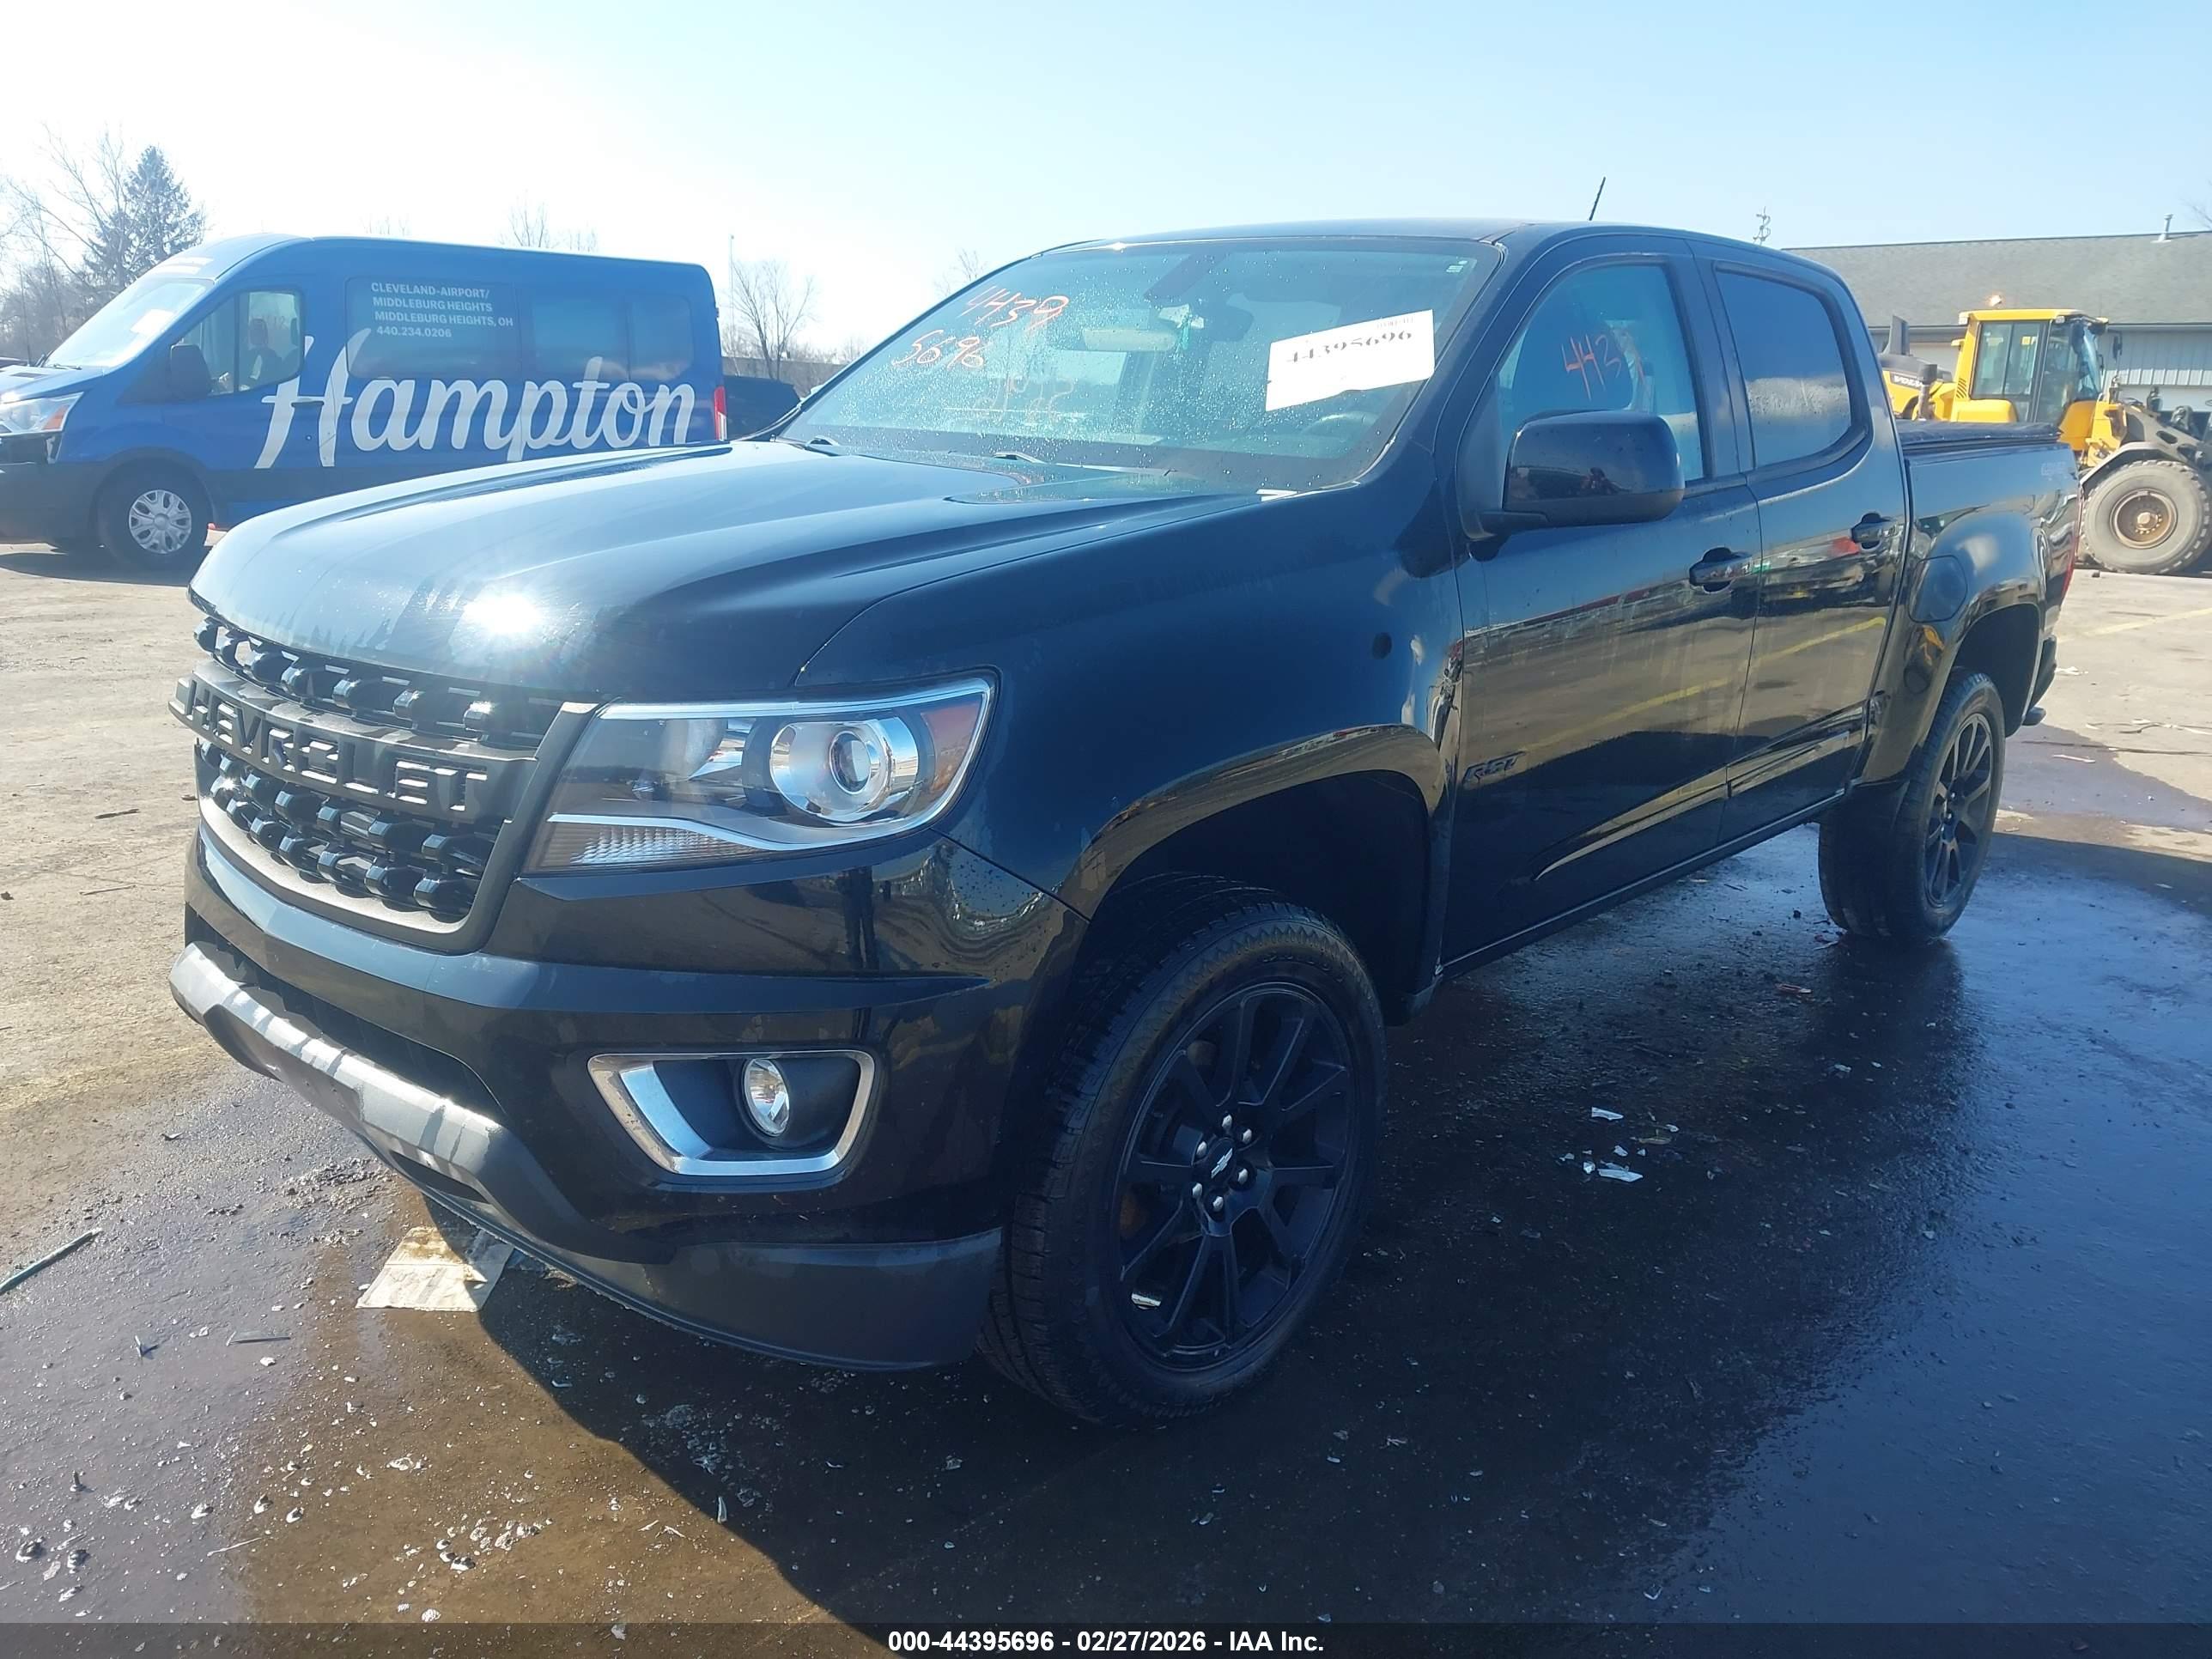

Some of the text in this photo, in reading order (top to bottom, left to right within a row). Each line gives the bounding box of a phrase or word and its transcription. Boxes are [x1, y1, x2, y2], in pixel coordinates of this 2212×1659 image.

[371, 282, 490, 300] CLEVELAND-AIRPORT/
[373, 296, 493, 313] MIDDLEBURG HEIGHTS
[956, 285, 1070, 333] 4439
[374, 311, 514, 327] MIDDLEBURG HEIGHTS, OH
[376, 325, 453, 337] 440.234.0206
[891, 329, 986, 371] 5696
[254, 327, 696, 469] Hampton
